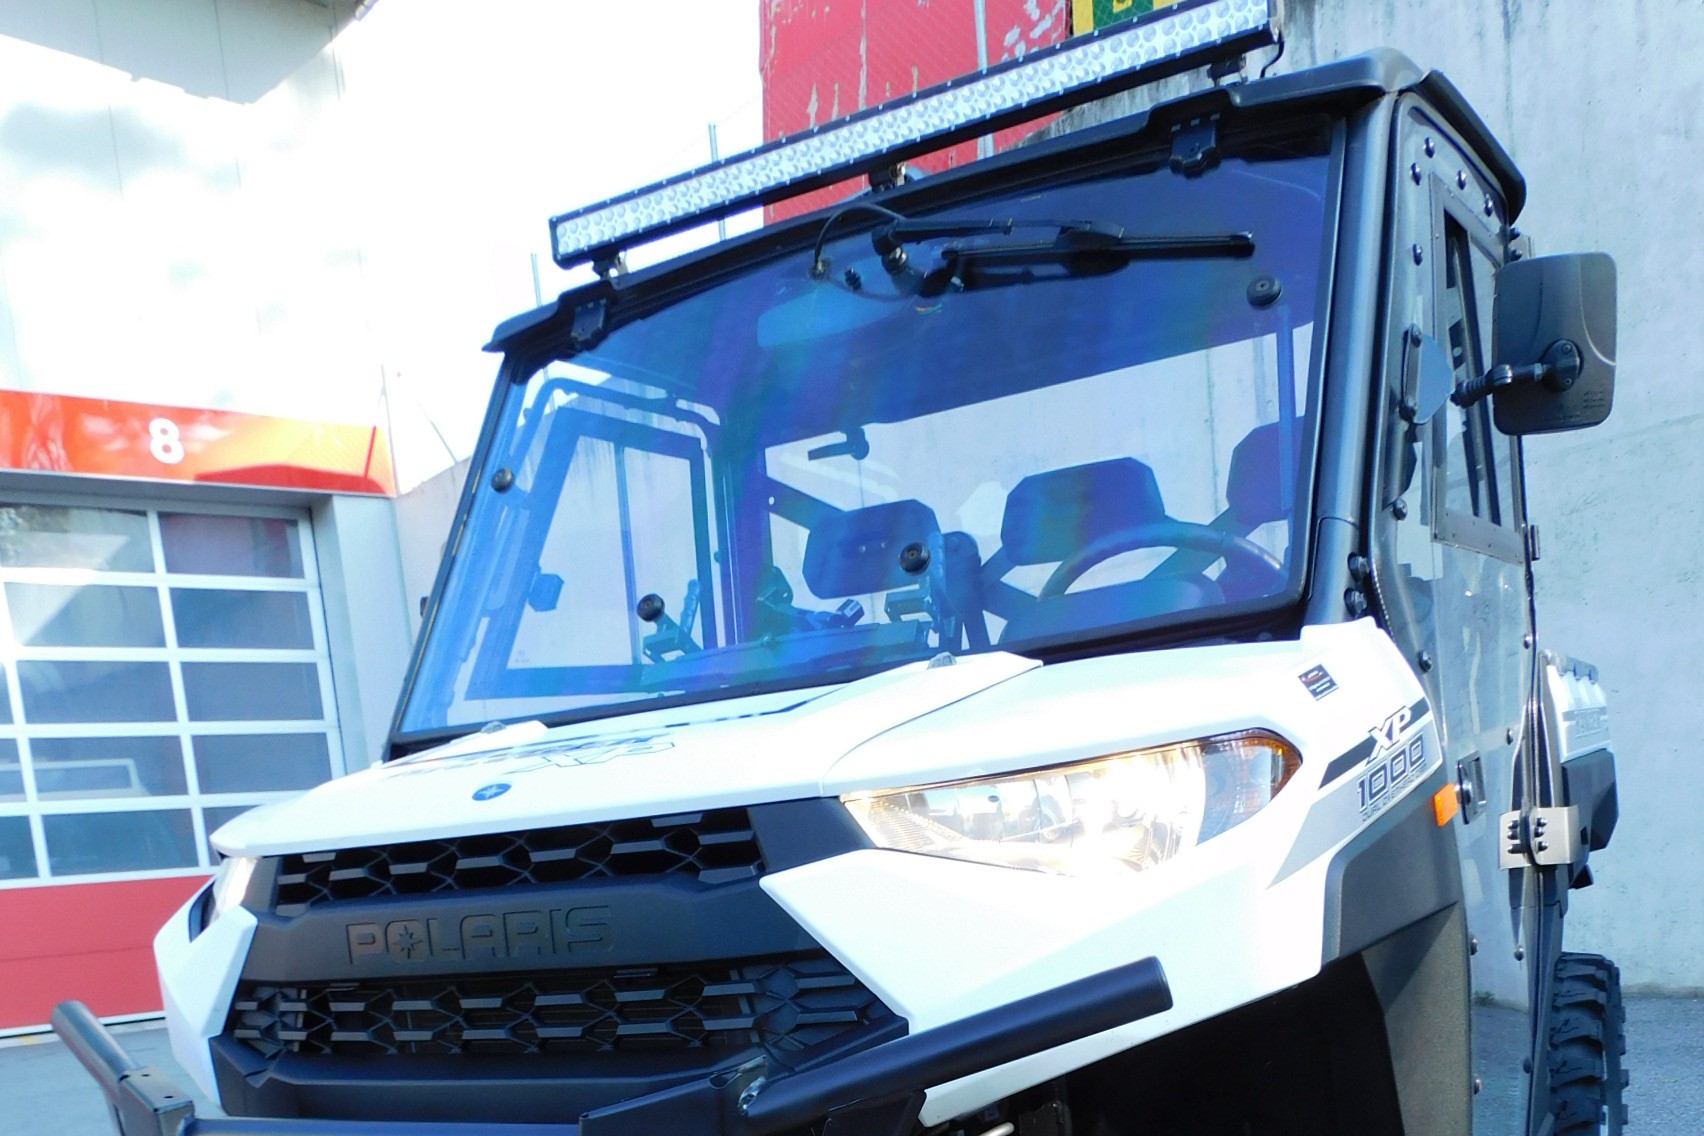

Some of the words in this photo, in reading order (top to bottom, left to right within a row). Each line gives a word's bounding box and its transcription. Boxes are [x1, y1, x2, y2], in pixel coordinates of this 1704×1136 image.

[148, 417, 185, 464] 8
[1365, 705, 1411, 767] XP
[1357, 731, 1425, 814] 1000
[346, 905, 616, 965] POLARIS
